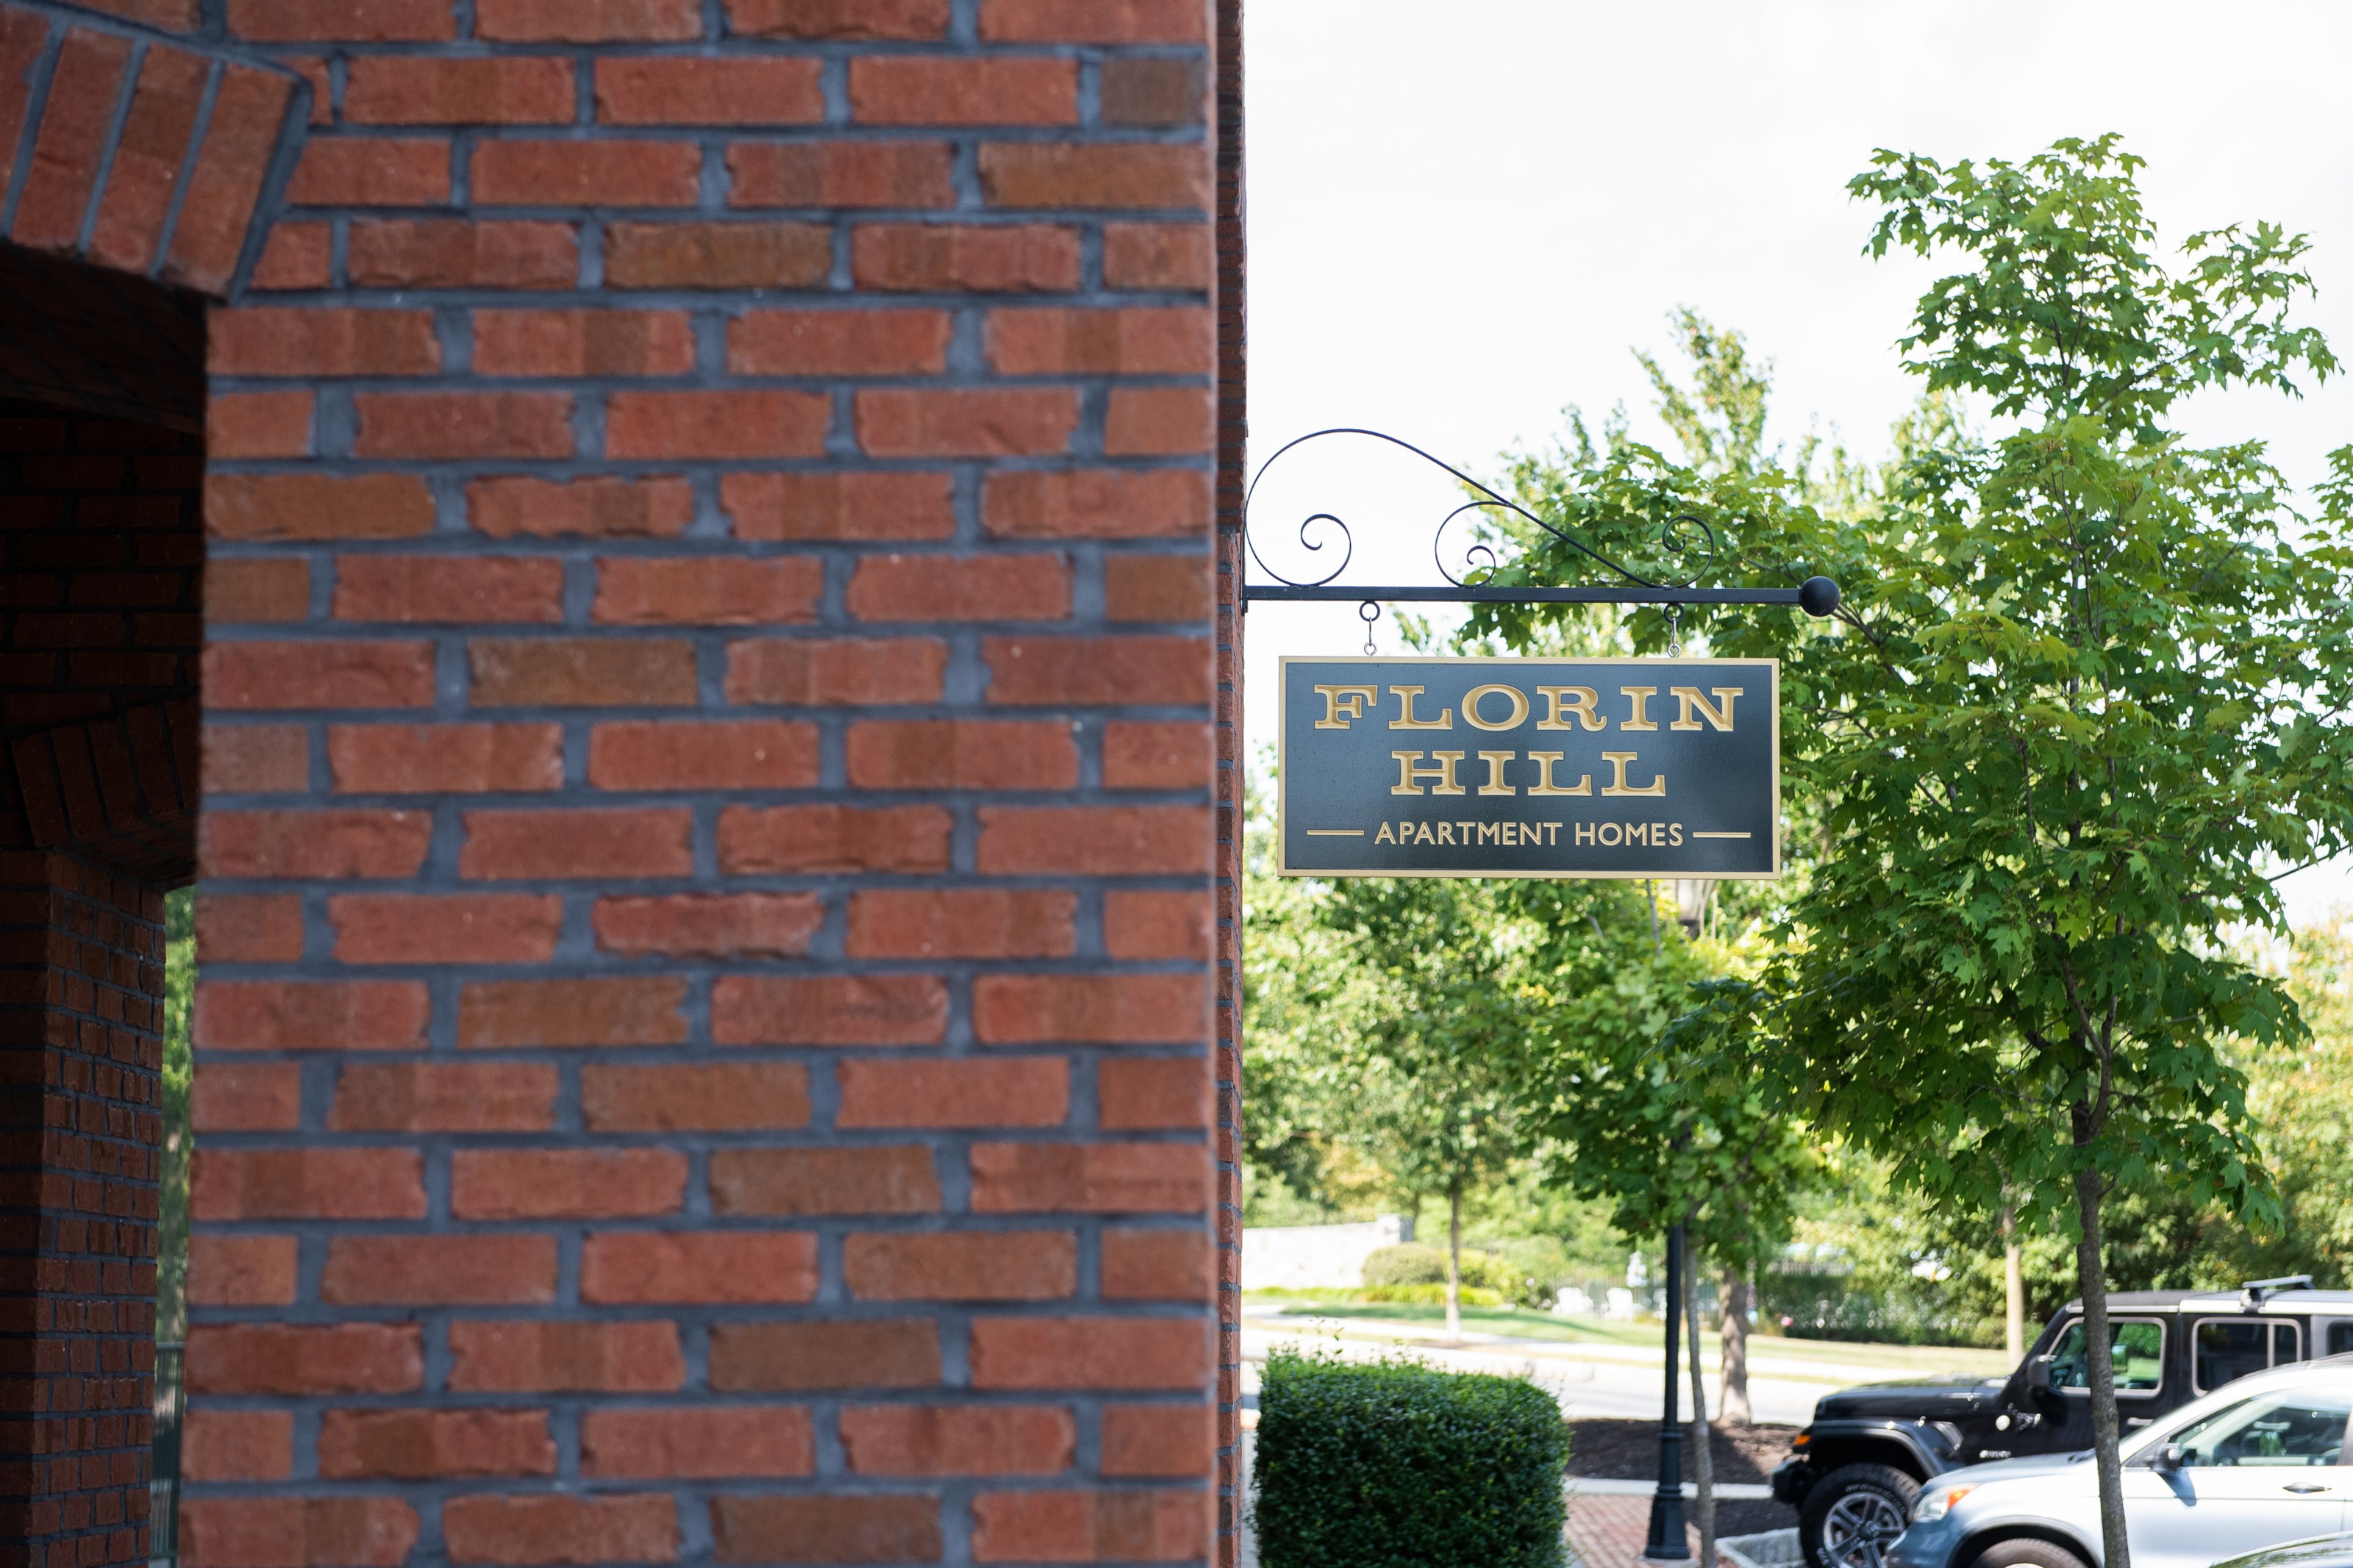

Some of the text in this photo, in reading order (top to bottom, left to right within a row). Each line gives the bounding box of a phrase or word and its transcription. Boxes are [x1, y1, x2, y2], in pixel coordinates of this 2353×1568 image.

[1313, 684, 1744, 732] FLORIN
[1390, 750, 1667, 798] HILL
[1374, 821, 1684, 847] APARTMENT HOMES
